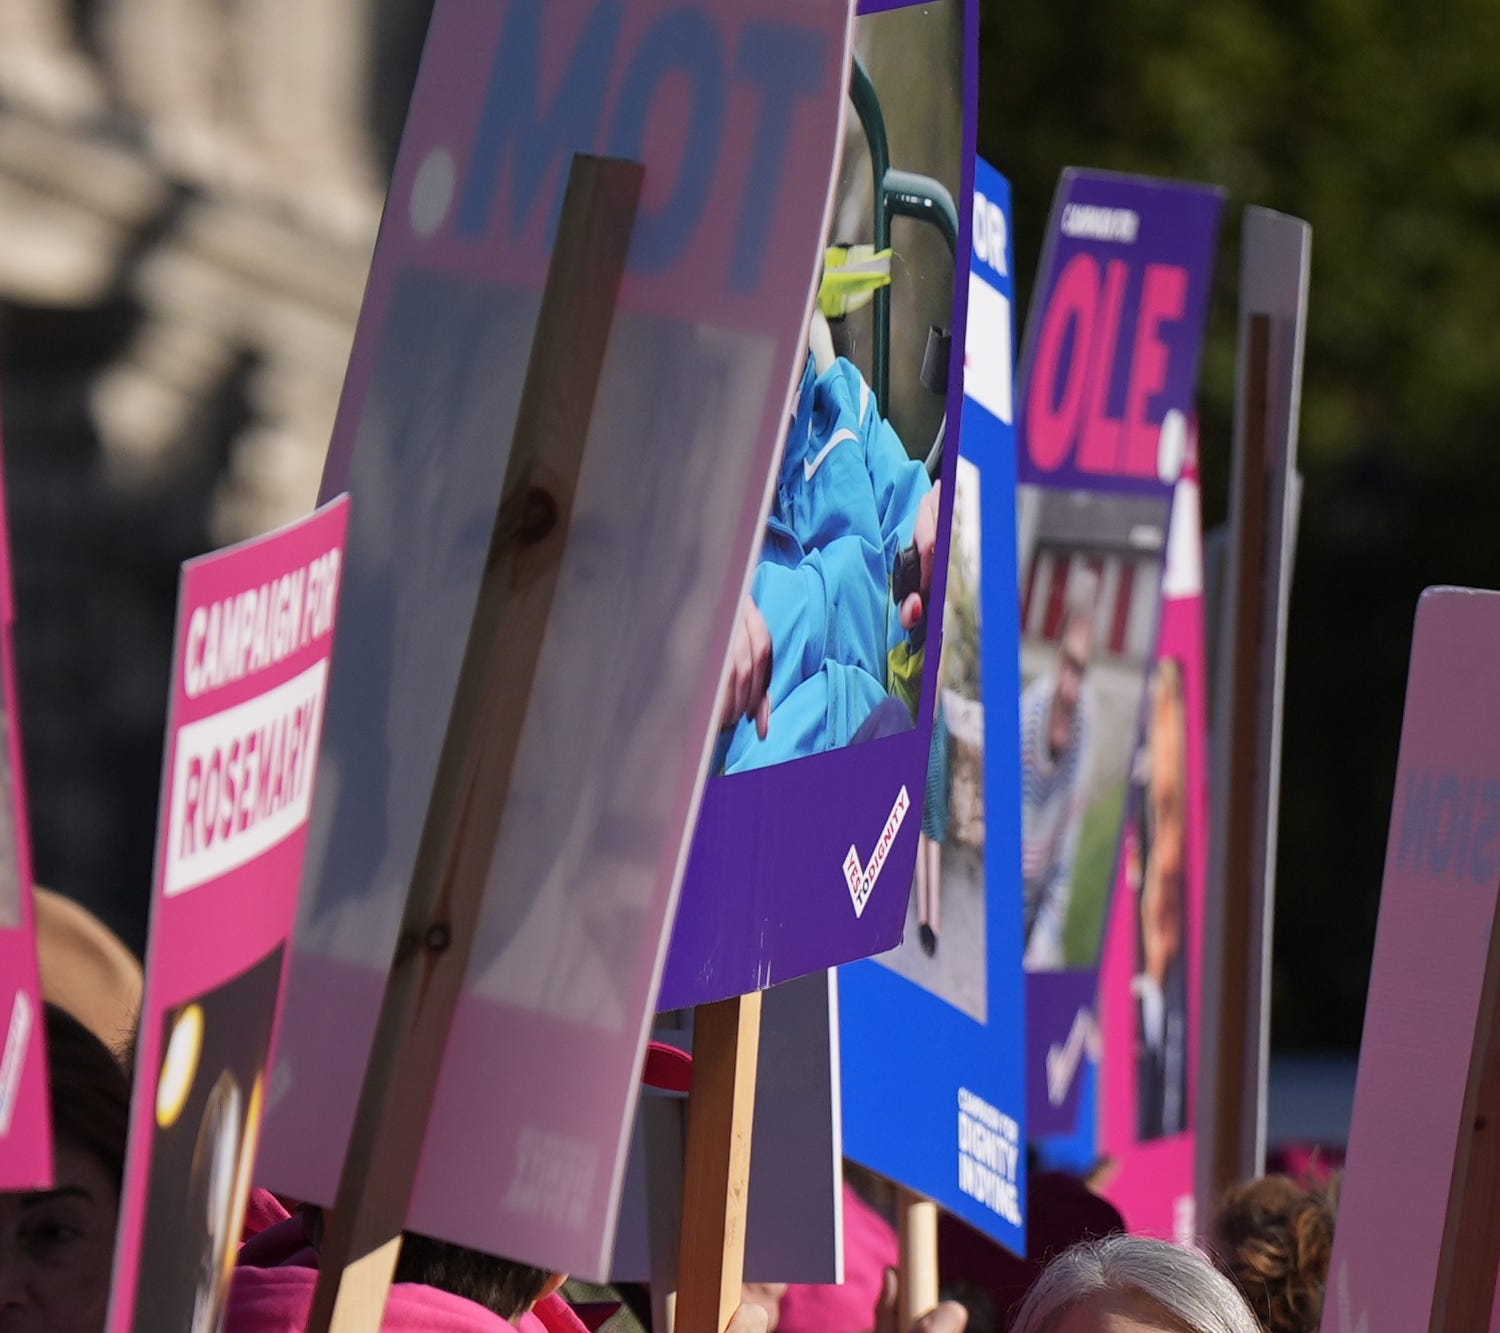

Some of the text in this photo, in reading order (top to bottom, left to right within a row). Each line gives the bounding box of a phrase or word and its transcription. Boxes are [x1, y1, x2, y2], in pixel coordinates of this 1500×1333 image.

[972, 190, 1008, 278] OR
[184, 547, 342, 699] CAMPAIGN FOR
[179, 693, 317, 860] ROSEMARY
[847, 851, 862, 895] YES
